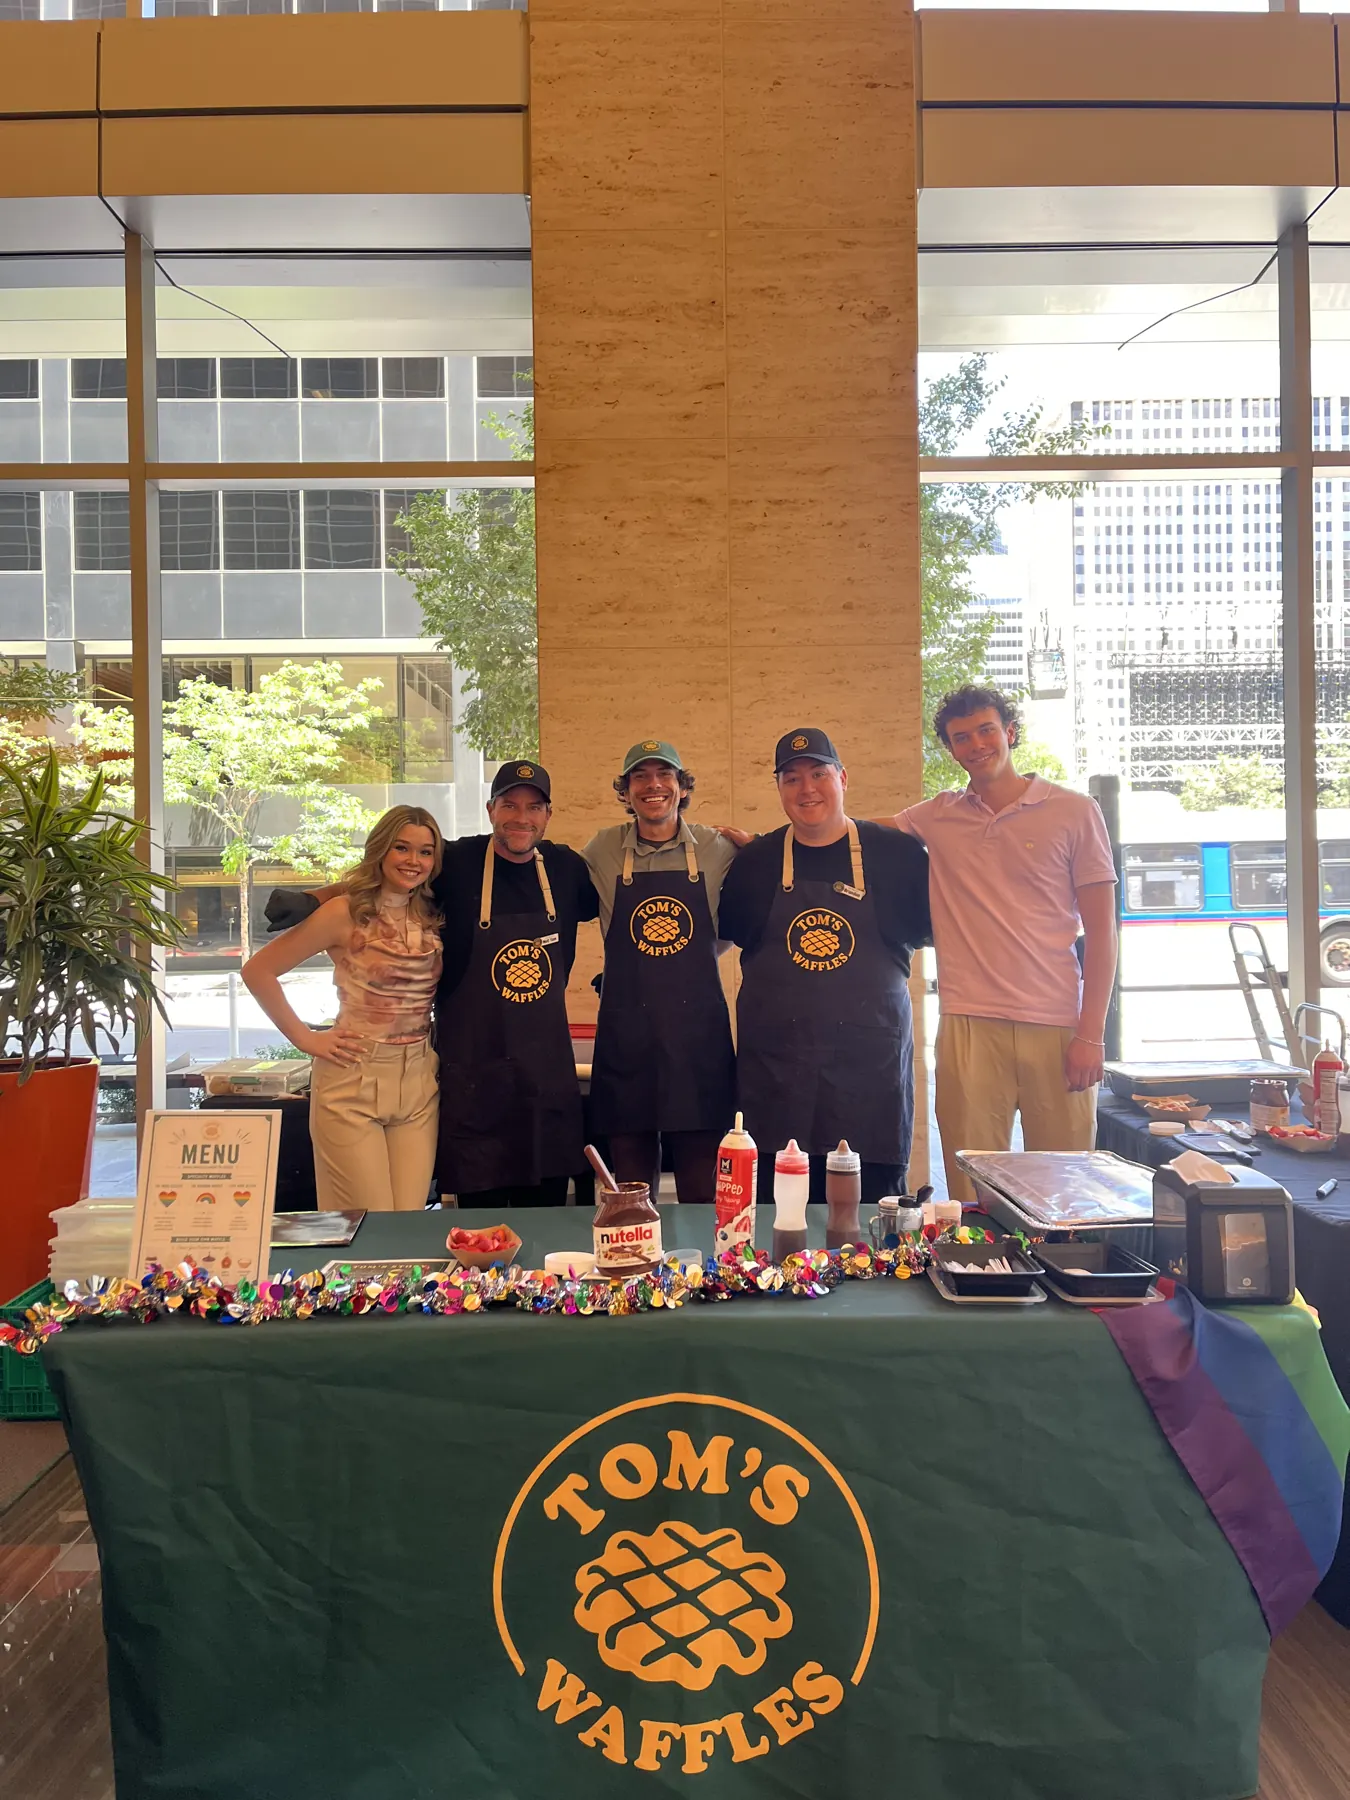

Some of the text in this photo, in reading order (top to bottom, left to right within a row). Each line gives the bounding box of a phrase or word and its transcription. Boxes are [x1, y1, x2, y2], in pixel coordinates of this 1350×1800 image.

[637, 902, 682, 920] TOM'S
[796, 914, 843, 931] TOM'S
[499, 945, 541, 965] TOM'S
[637, 936, 689, 957] WAFFLES
[792, 952, 848, 971] WAFFLES
[501, 980, 550, 1003] WAFFLES
[181, 1144, 240, 1165] MENU
[600, 1226, 653, 1244] nutella
[543, 1430, 810, 1536] TOM'S
[537, 1658, 844, 1775] WAFFLES
